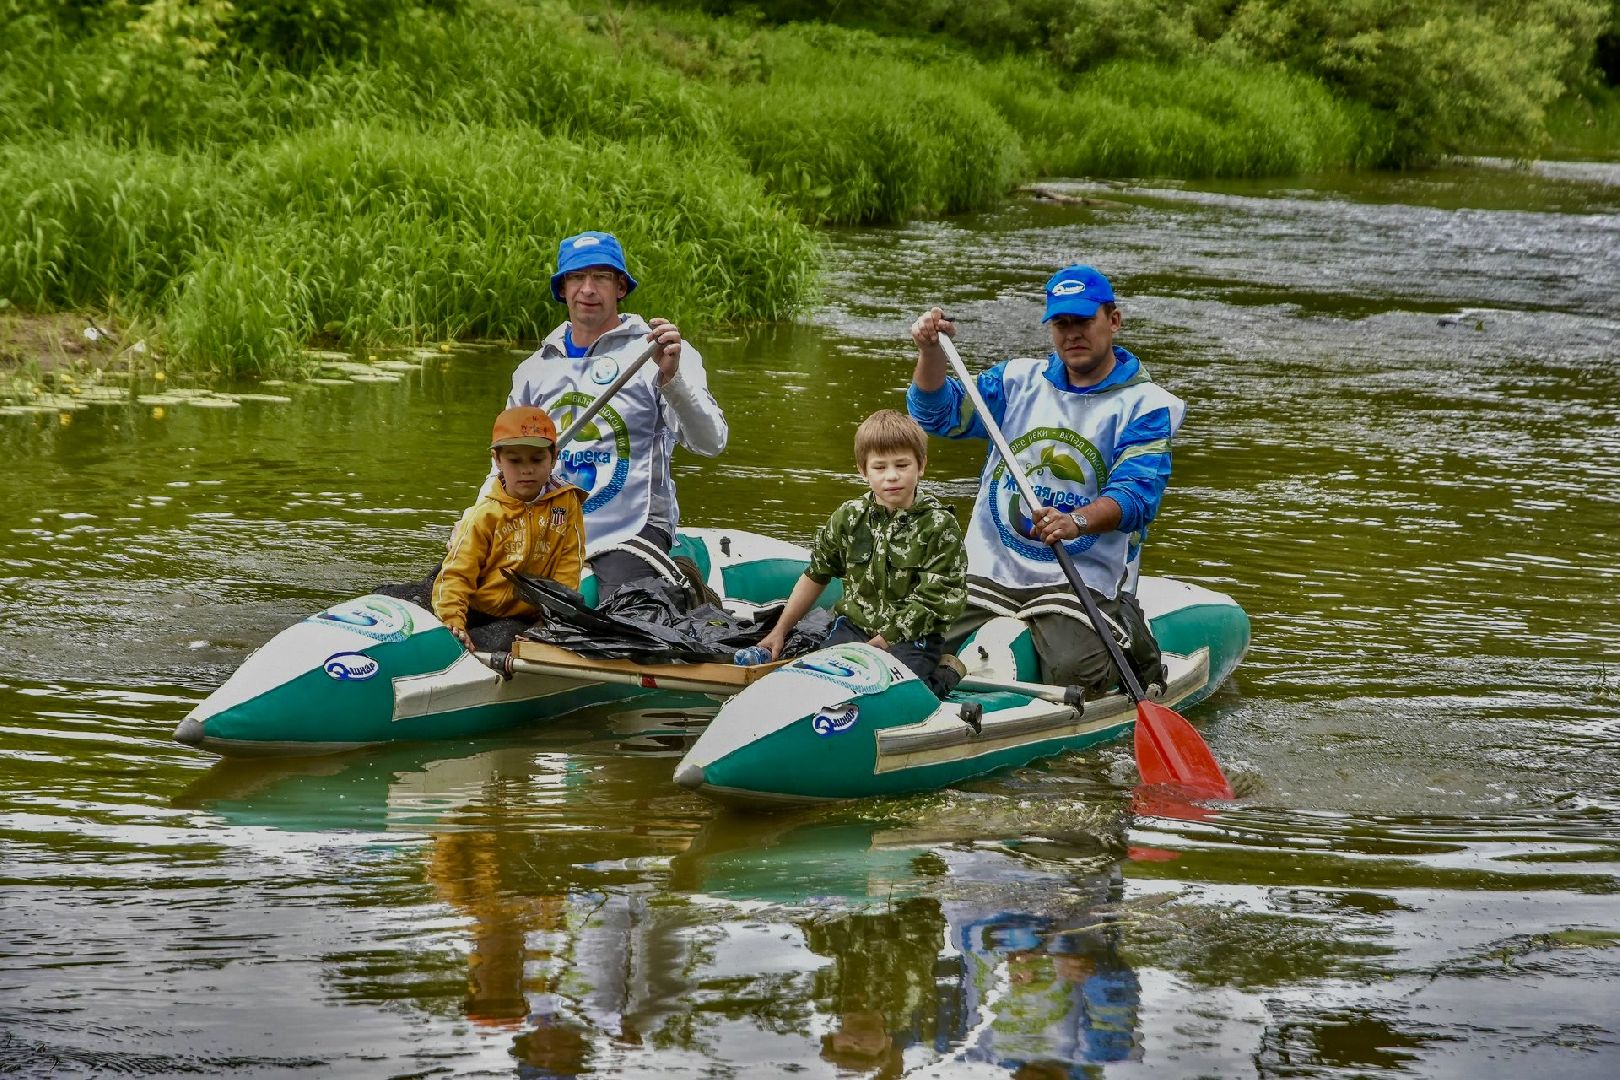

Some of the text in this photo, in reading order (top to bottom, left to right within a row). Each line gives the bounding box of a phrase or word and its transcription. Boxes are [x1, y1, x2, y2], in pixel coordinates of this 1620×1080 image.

[573, 450, 611, 466] река
[1003, 474, 1092, 507] Жая река
